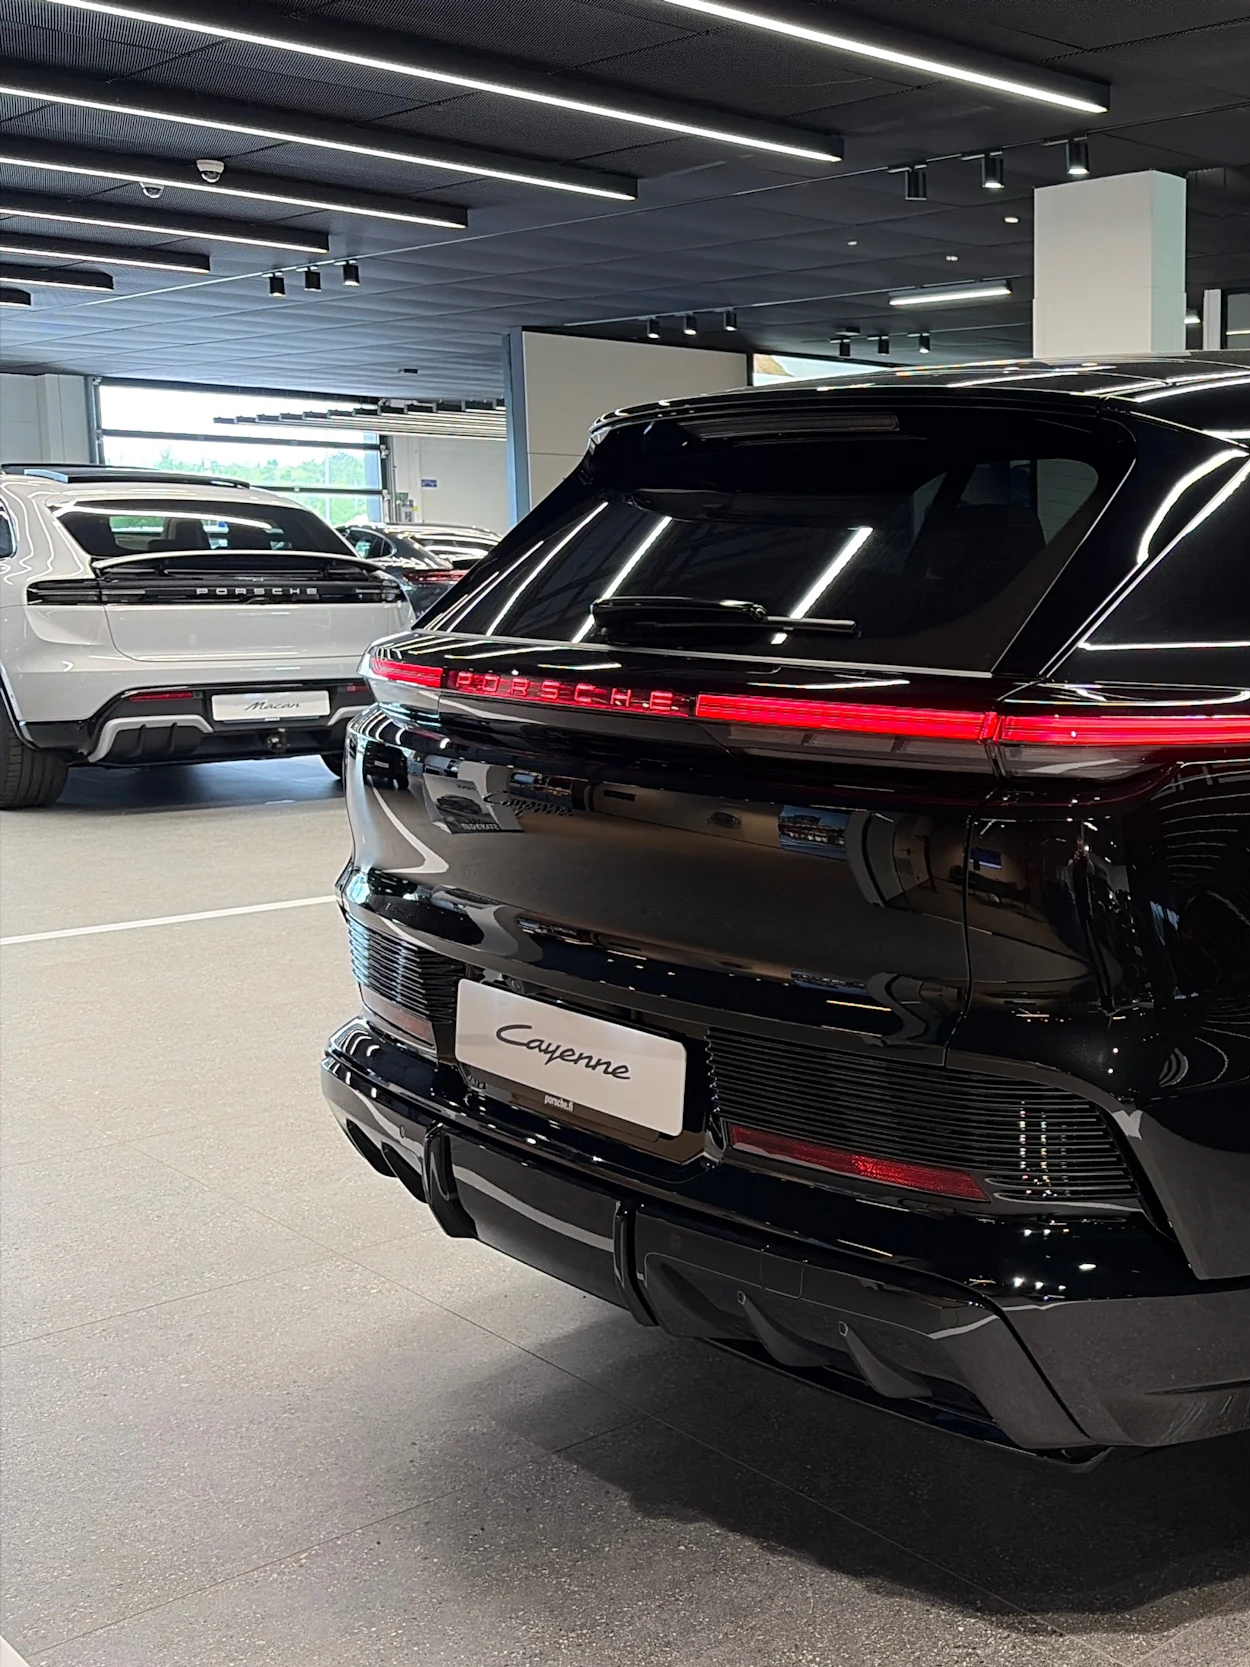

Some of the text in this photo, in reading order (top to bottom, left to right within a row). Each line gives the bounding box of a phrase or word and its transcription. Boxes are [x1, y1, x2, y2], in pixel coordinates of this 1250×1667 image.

[196, 587, 318, 596] PORSCHE
[456, 671, 673, 711] PORSCHE
[244, 701, 301, 711] Macan
[483, 790, 573, 817] Cayenne
[495, 1024, 631, 1080] Cayenne
[544, 1094, 574, 1112] porsche.fi
